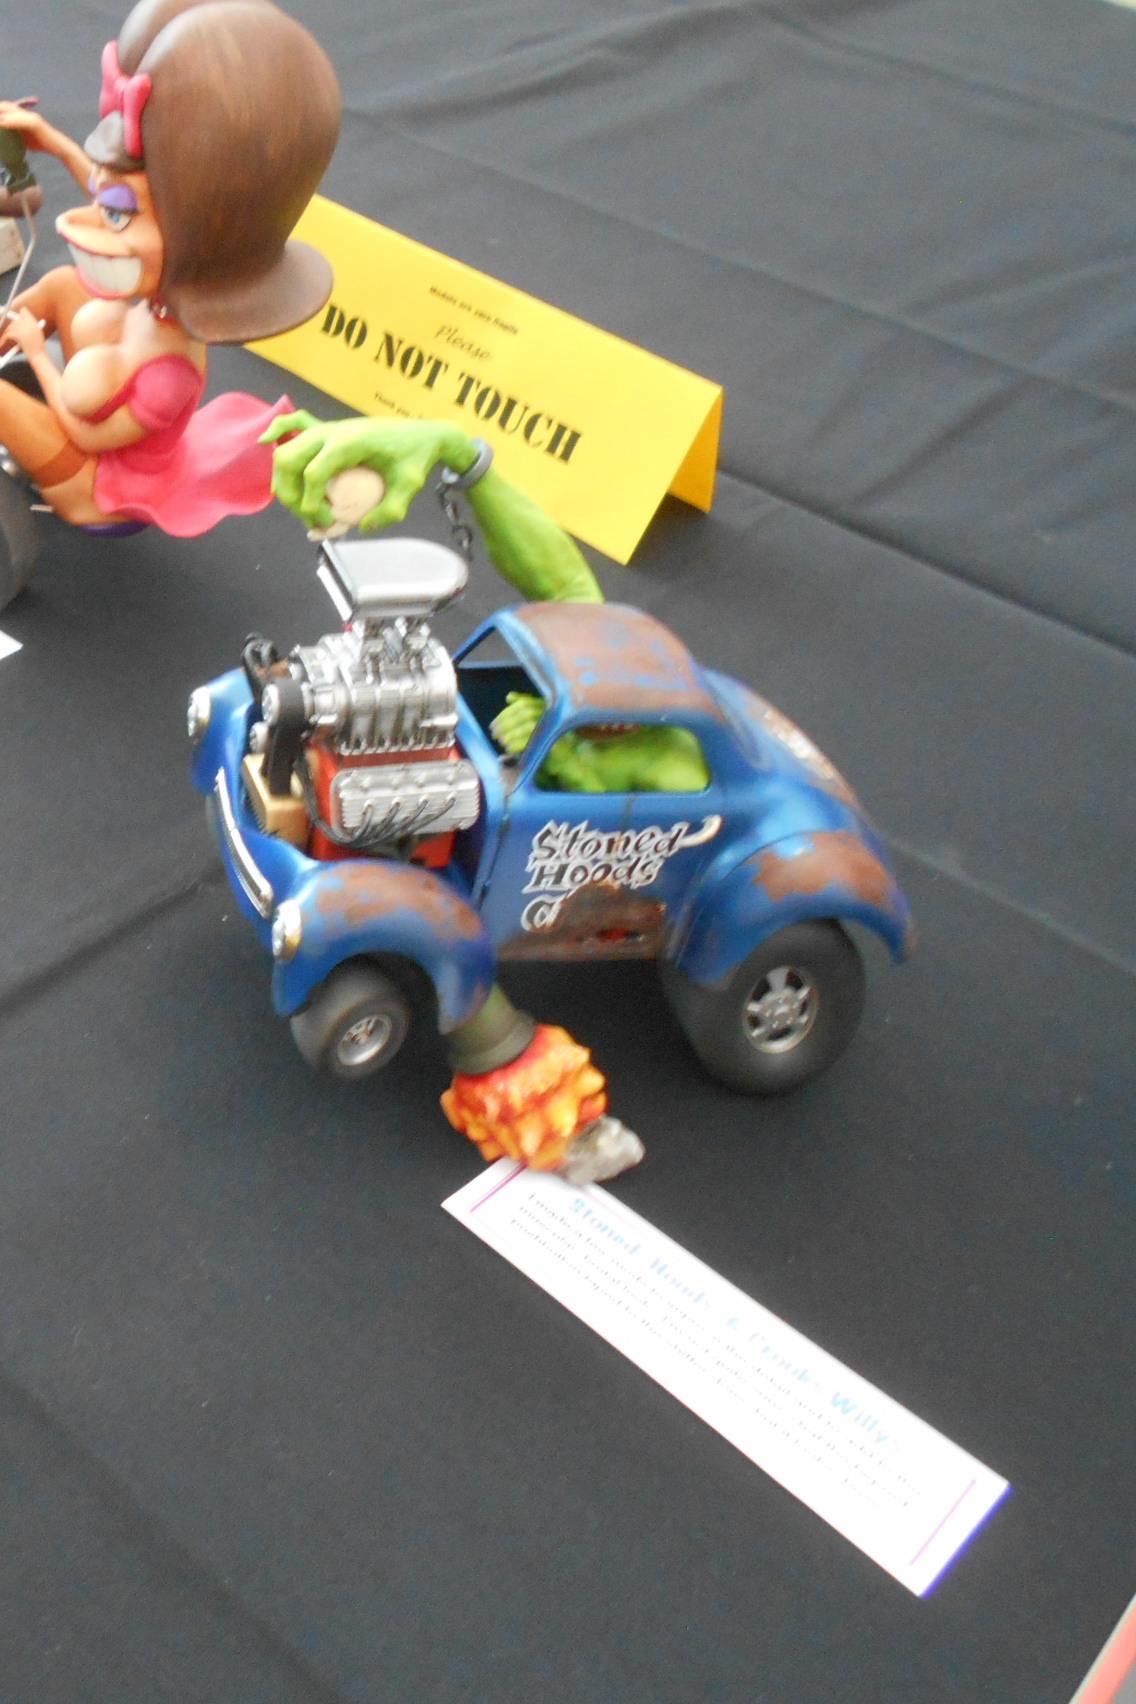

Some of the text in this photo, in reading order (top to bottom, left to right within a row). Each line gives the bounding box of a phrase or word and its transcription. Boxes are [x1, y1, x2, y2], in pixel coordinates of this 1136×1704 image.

[434, 325, 491, 361] Please
[321, 303, 583, 465] DO NOT TOUCH
[528, 818, 692, 863] Stoned
[521, 854, 666, 893] Hoods
